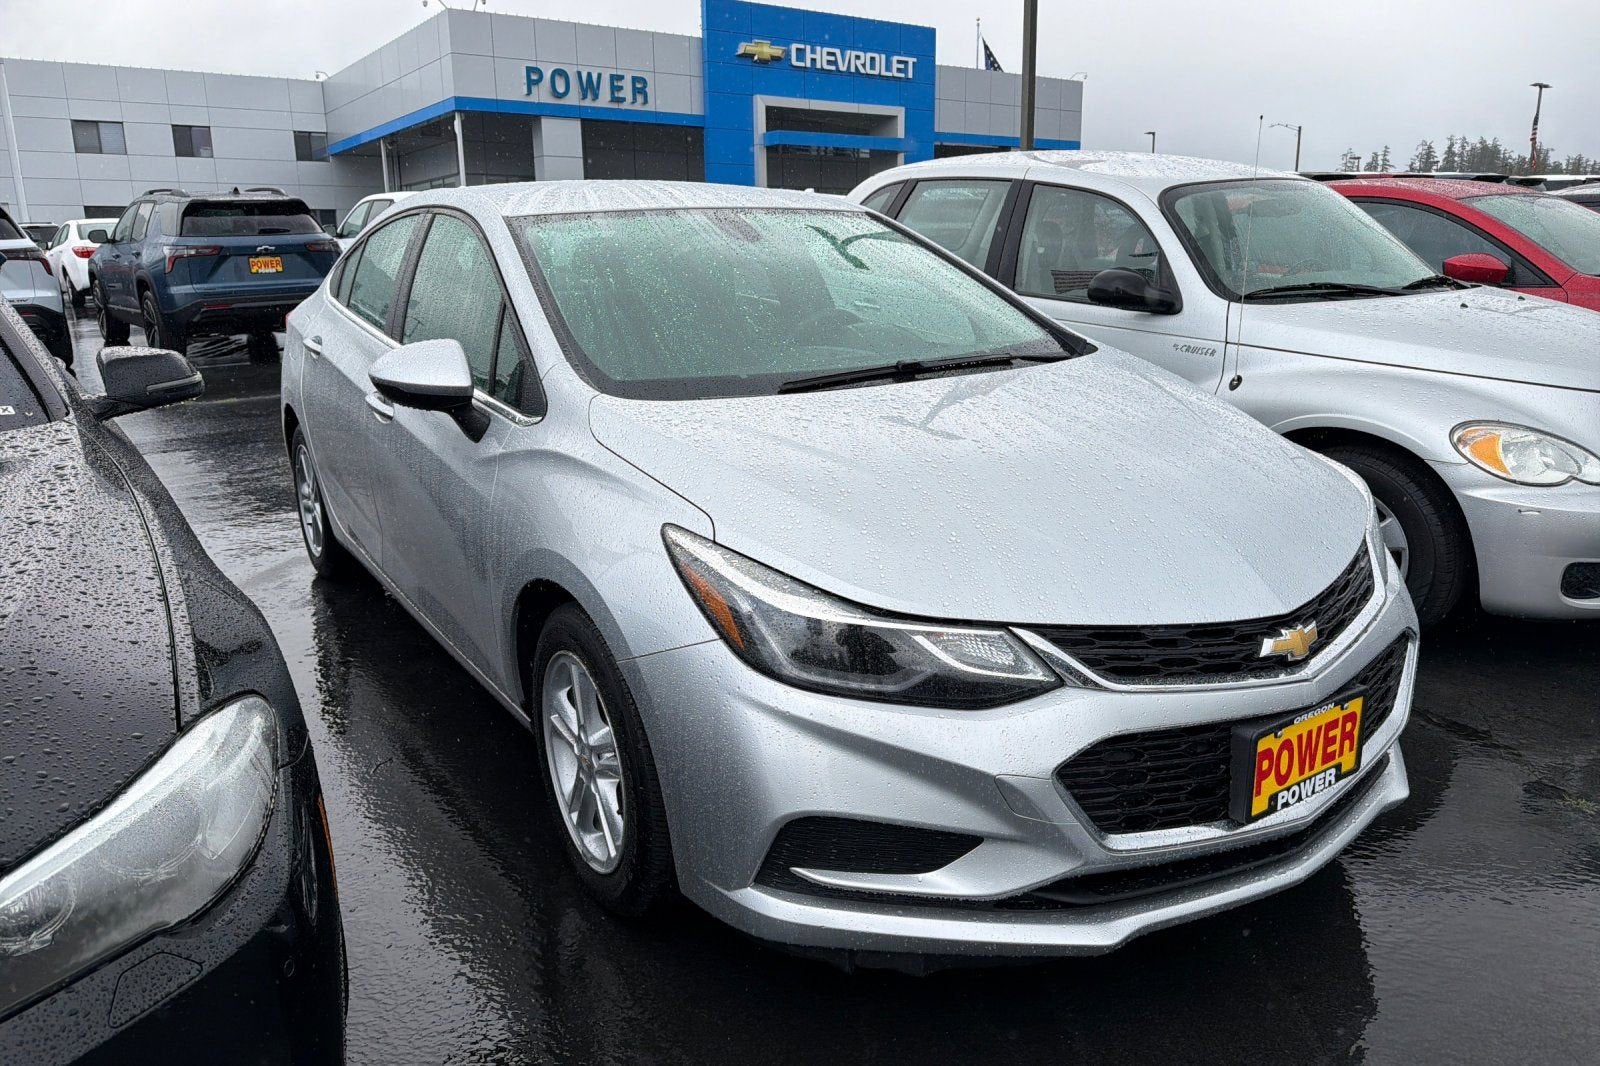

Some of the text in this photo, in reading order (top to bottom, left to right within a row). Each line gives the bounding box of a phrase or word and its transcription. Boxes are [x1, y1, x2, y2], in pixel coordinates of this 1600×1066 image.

[791, 43, 917, 78] CHEVROLET
[525, 66, 648, 105] POWER
[251, 259, 282, 269] POWER
[1180, 344, 1217, 357] CRUISER
[1293, 702, 1335, 725] OREGON
[1255, 710, 1358, 797] POWER
[1277, 767, 1336, 810] POWER
